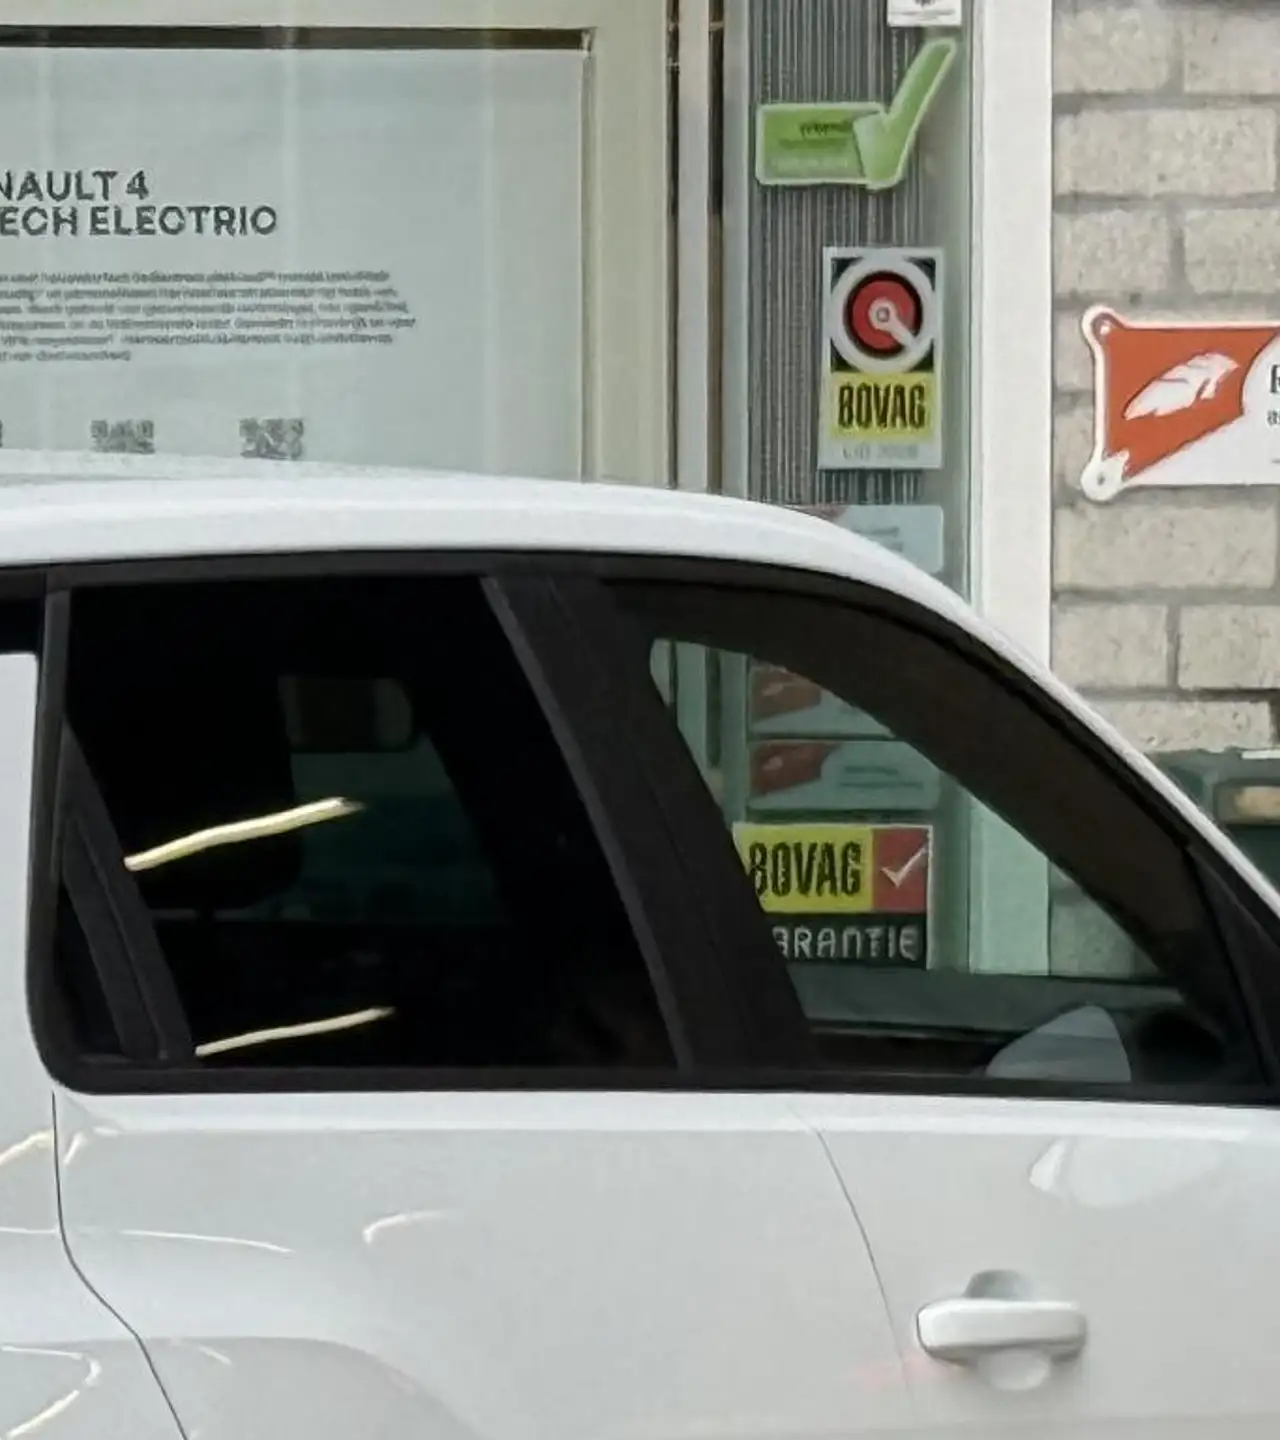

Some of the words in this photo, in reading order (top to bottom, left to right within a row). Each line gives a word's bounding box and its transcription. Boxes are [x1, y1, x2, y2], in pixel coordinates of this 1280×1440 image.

[125, 170, 150, 201] 4
[837, 382, 927, 431] BOVAG
[748, 841, 862, 898] BOVAG
